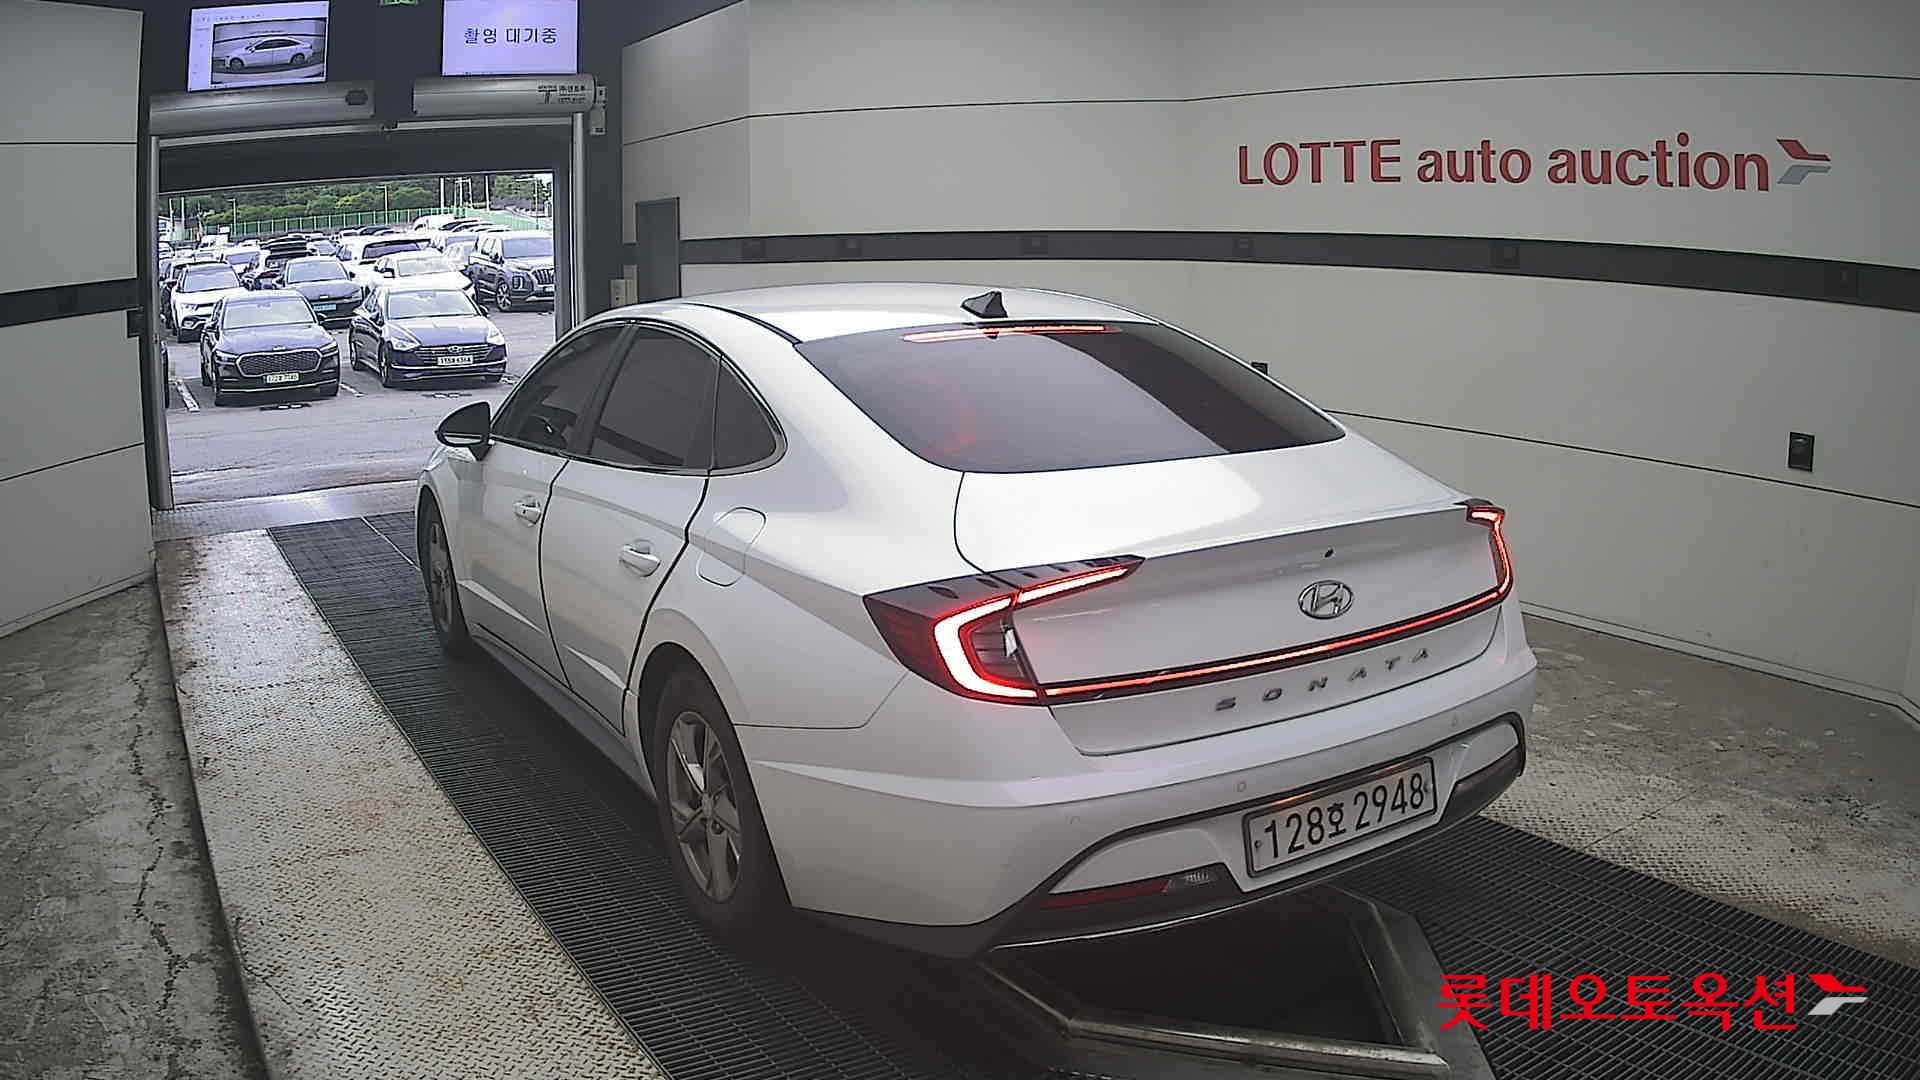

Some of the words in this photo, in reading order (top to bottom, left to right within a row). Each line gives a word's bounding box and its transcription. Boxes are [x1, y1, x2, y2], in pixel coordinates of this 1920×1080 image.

[463, 27, 497, 44] 촬영
[506, 27, 558, 44] 대기중
[1238, 138, 1401, 186] LOTTE
[1416, 139, 1532, 185] auto
[1546, 132, 1770, 192] auction
[1214, 647, 1430, 712] SONATA
[1263, 802, 1347, 859] 128호
[1353, 772, 1425, 832] 2948
